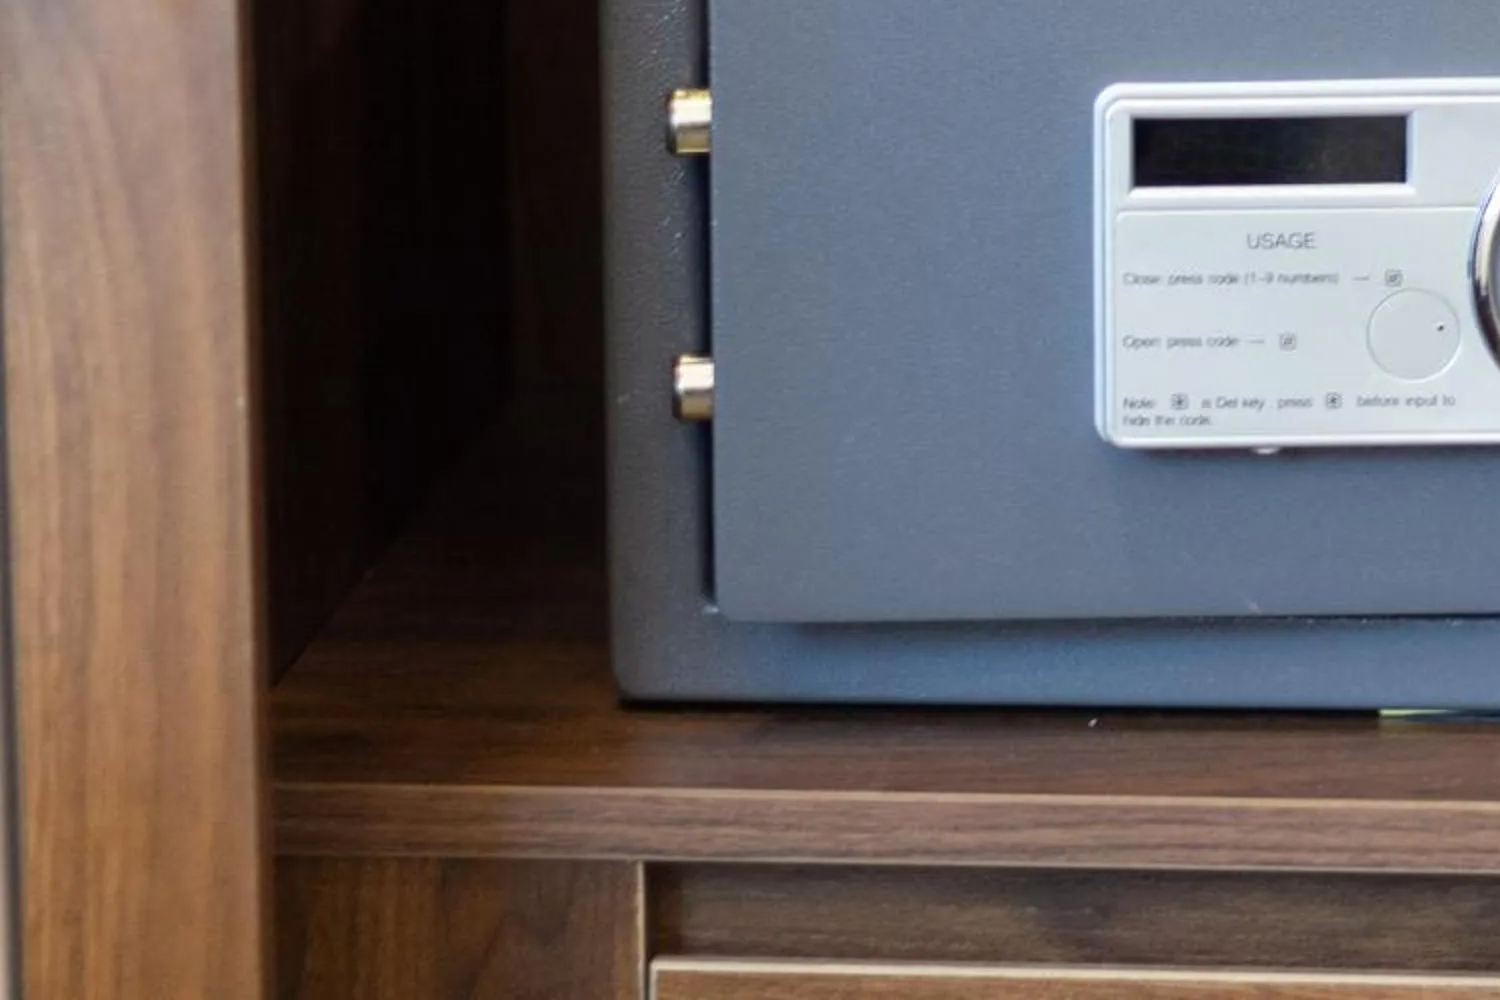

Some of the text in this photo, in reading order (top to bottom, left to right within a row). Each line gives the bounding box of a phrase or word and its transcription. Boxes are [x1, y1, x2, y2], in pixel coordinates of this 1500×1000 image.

[1246, 231, 1317, 250] USAGE
[1168, 274, 1203, 286] press
[1208, 273, 1239, 285] code
[1167, 336, 1203, 349] press
[1206, 335, 1239, 348] code
[1442, 394, 1456, 407] to
